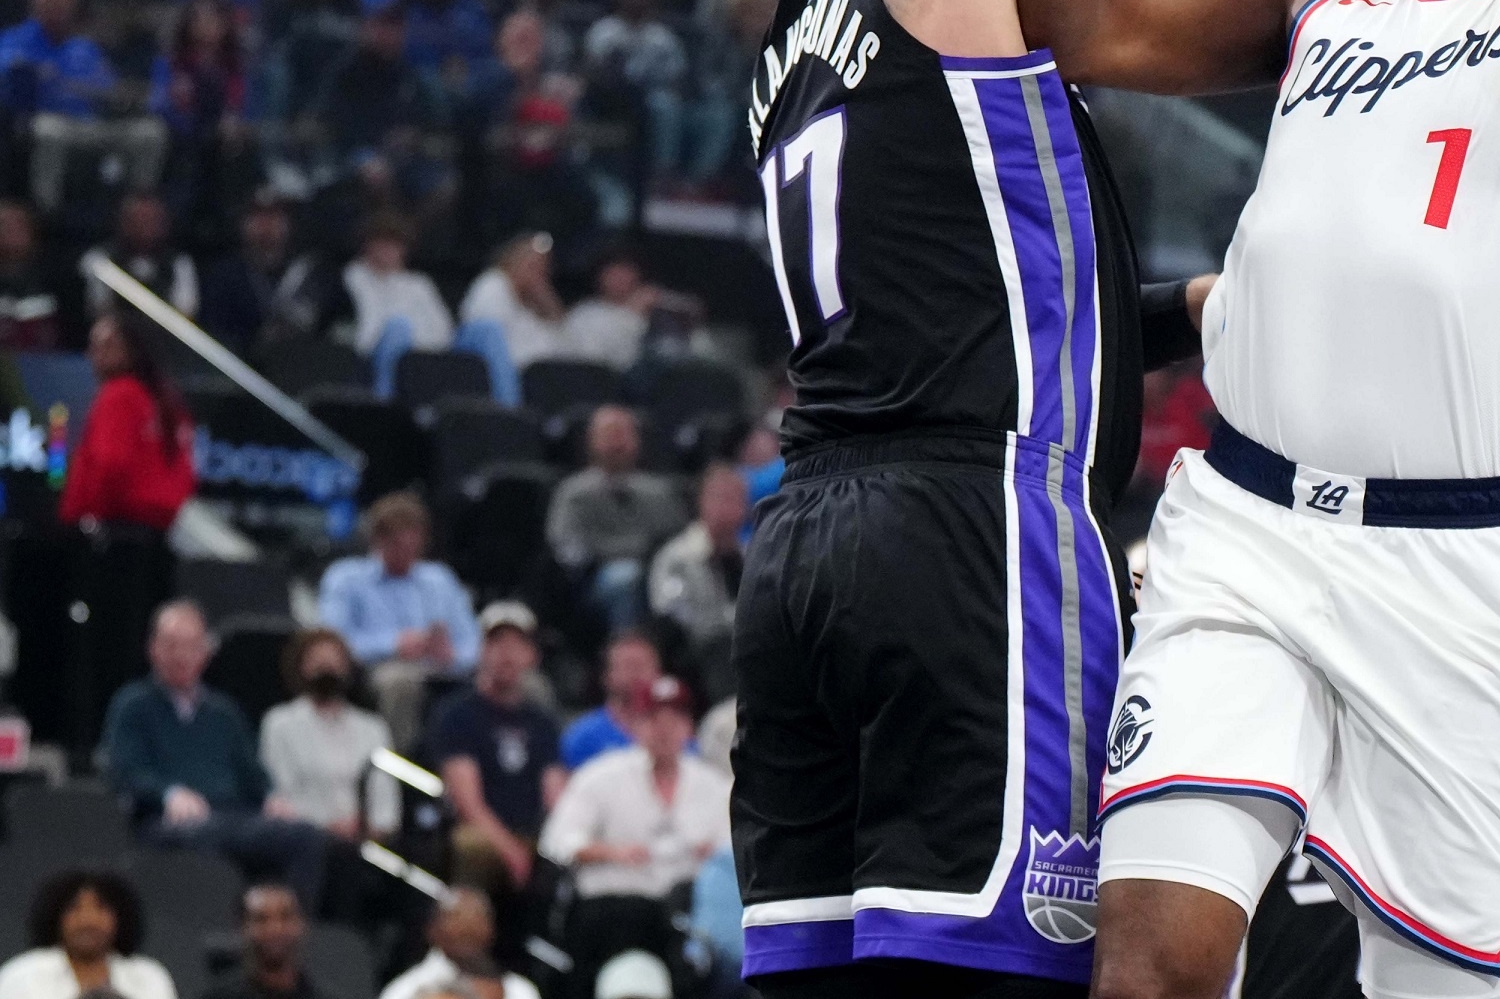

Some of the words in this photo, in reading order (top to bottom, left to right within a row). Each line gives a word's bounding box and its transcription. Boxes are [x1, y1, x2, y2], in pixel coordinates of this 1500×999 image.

[1425, 127, 1472, 230] 1
[1034, 860, 1098, 876] SACRAMEN
[1027, 872, 1099, 902] KING
